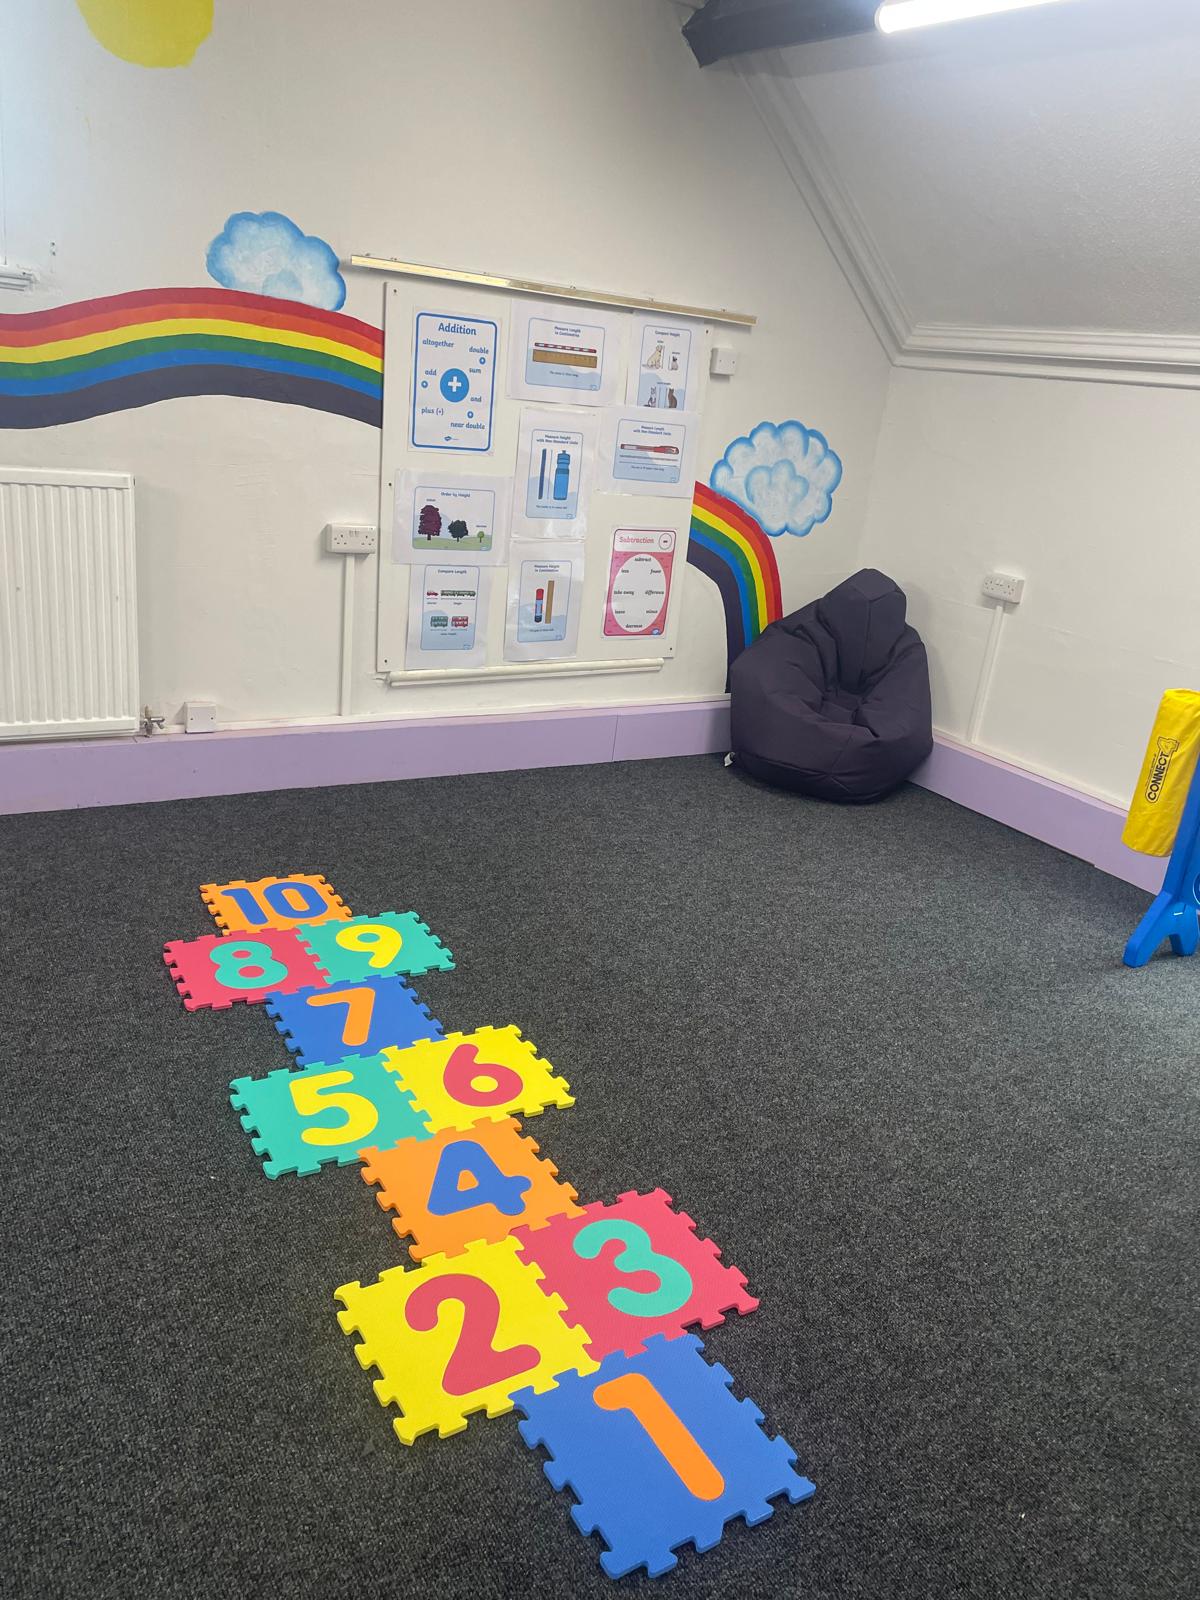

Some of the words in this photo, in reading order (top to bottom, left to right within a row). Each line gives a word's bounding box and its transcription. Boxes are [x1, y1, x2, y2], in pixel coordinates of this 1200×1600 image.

[422, 338, 454, 348] altogether
[438, 322, 477, 335] Addition
[469, 346, 489, 355] double
[421, 407, 434, 416] plus
[465, 422, 486, 430] double
[619, 536, 654, 544] Subtraction
[1157, 736, 1180, 753] 4
[1147, 751, 1169, 801] CONNECT
[221, 881, 329, 926] 10
[209, 940, 288, 990] 8
[335, 924, 403, 969] 9
[306, 987, 376, 1046] 7
[443, 1043, 524, 1107] 6
[289, 1070, 379, 1146] 5
[427, 1140, 533, 1216] 4
[572, 1218, 693, 1318] 3
[404, 1273, 542, 1397] 2
[593, 1373, 725, 1501] 1
